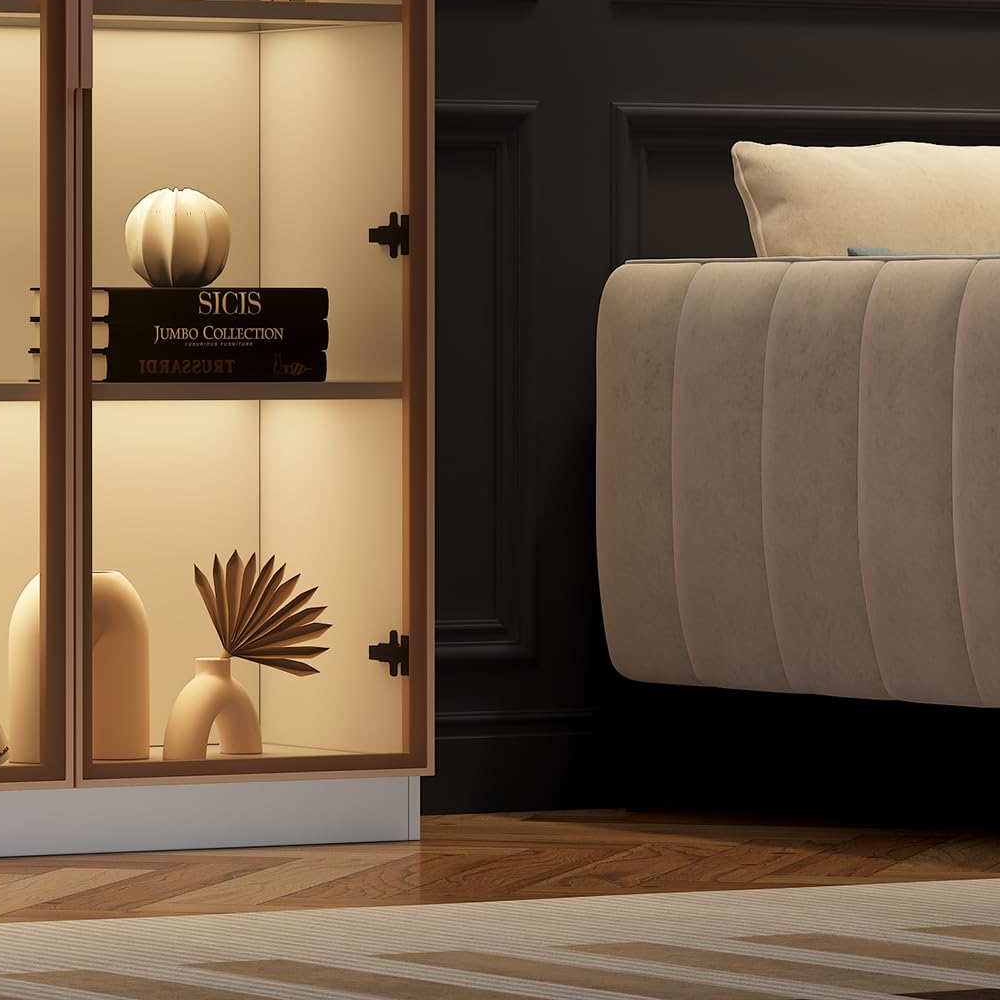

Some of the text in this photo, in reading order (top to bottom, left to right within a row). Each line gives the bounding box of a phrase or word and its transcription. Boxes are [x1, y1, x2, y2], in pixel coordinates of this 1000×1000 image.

[198, 291, 262, 315] SICIS
[153, 325, 284, 344] JUMBO COLLECTION
